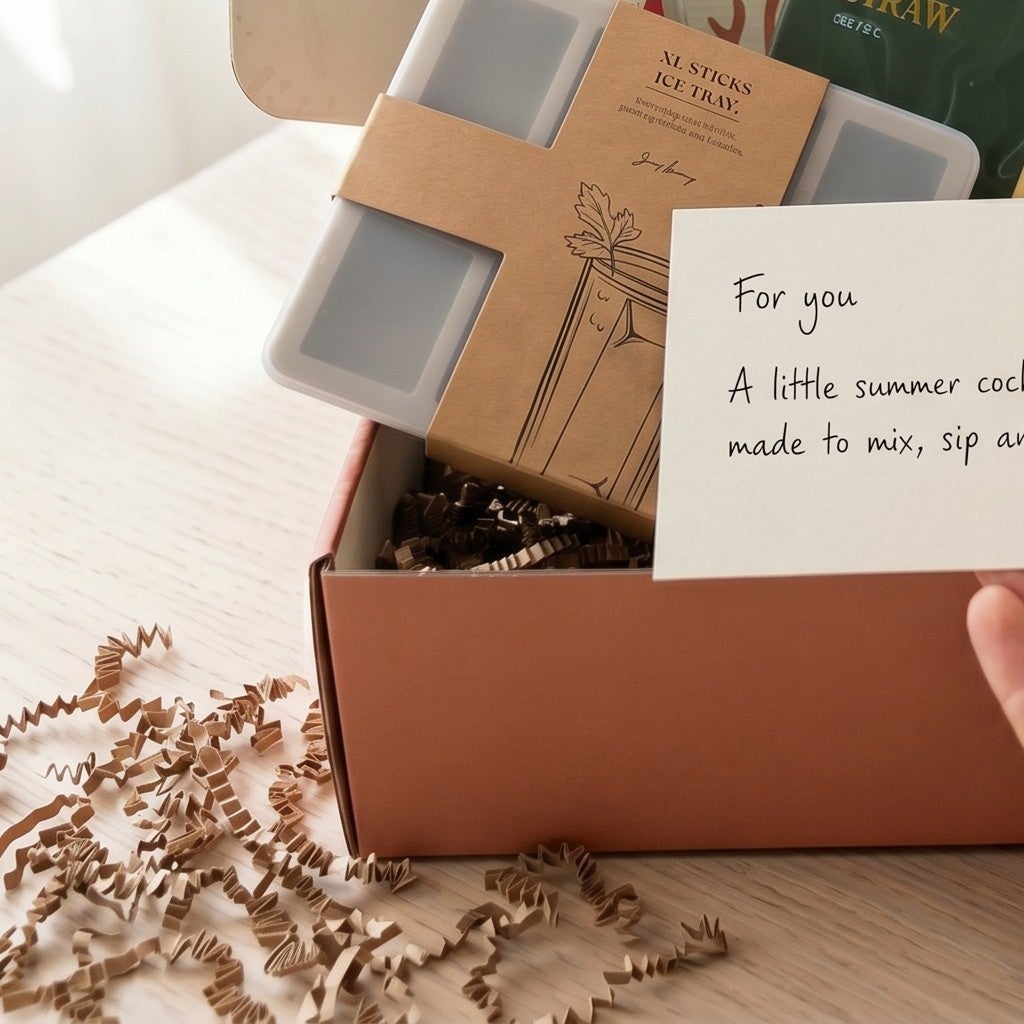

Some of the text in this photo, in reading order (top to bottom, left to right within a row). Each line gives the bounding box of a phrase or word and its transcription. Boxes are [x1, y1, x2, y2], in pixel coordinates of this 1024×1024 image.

[654, 71, 686, 93] ICE
[690, 84, 739, 115] TRAY.
[660, 50, 753, 96] XL STICKS
[734, 273, 858, 335] For you
[728, 366, 753, 404] A
[773, 366, 839, 400] little
[855, 377, 960, 399] summer
[728, 422, 806, 457] made
[822, 422, 849, 454] to
[868, 427, 924, 459] mix,
[942, 430, 979, 466] sip
